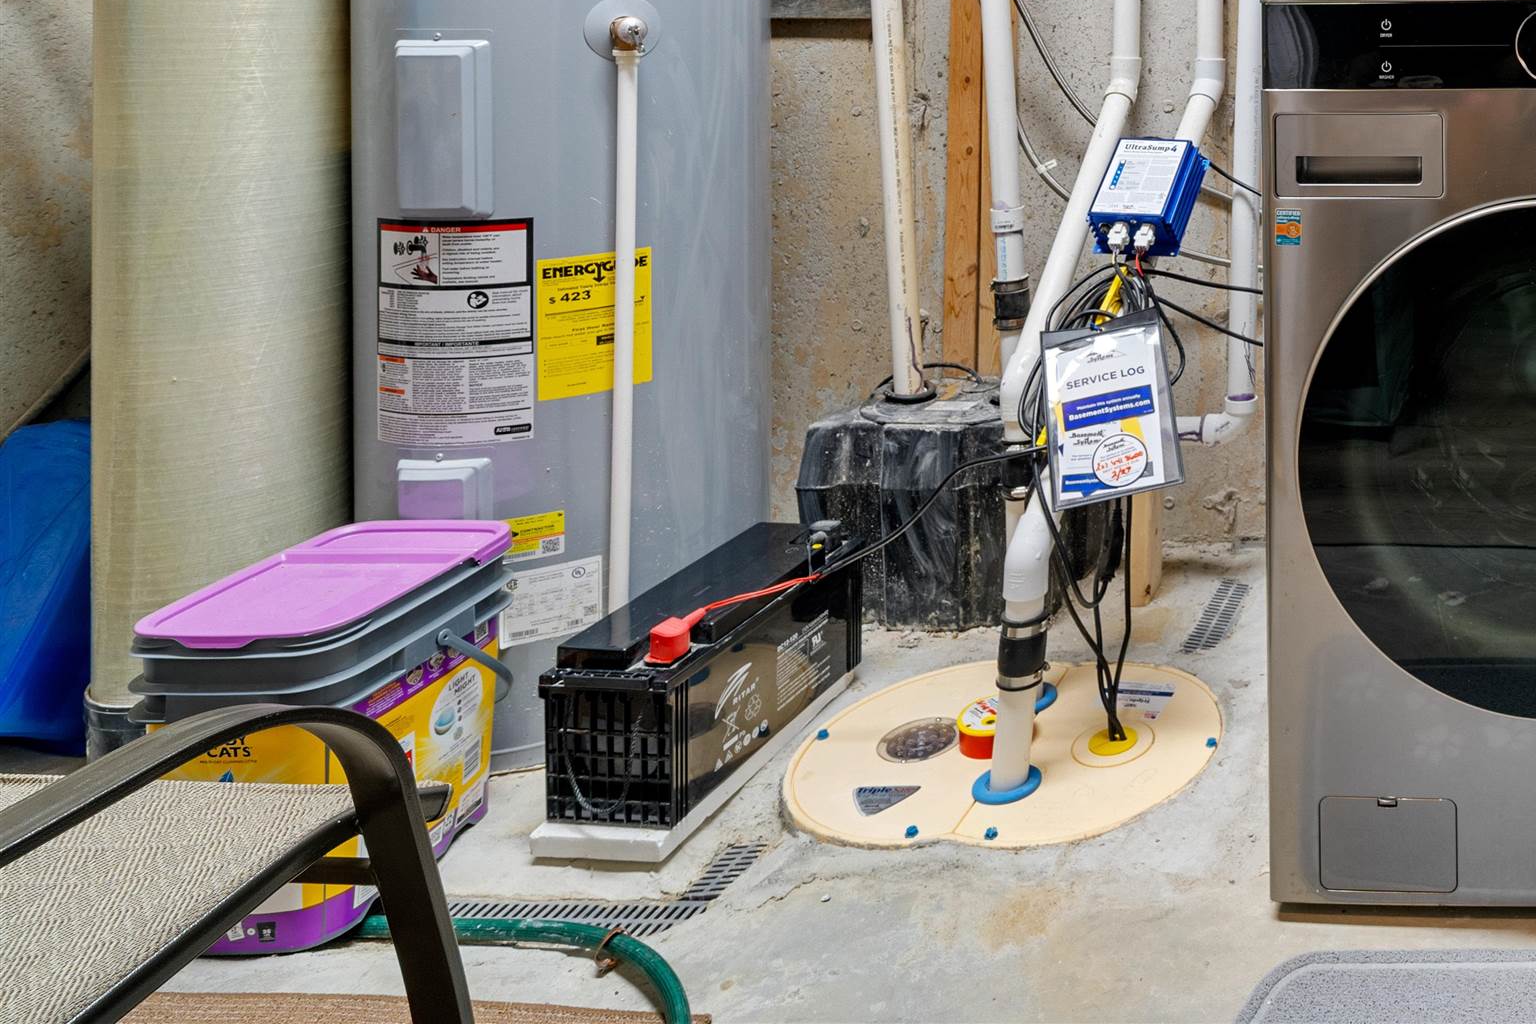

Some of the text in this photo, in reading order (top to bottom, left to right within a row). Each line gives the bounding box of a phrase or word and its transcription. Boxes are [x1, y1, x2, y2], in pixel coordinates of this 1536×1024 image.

[560, 289, 592, 302] 423
[1066, 366, 1145, 390] SERVICE LOG
[1068, 398, 1151, 422] BasementSystems.com
[207, 746, 251, 757] CATS
